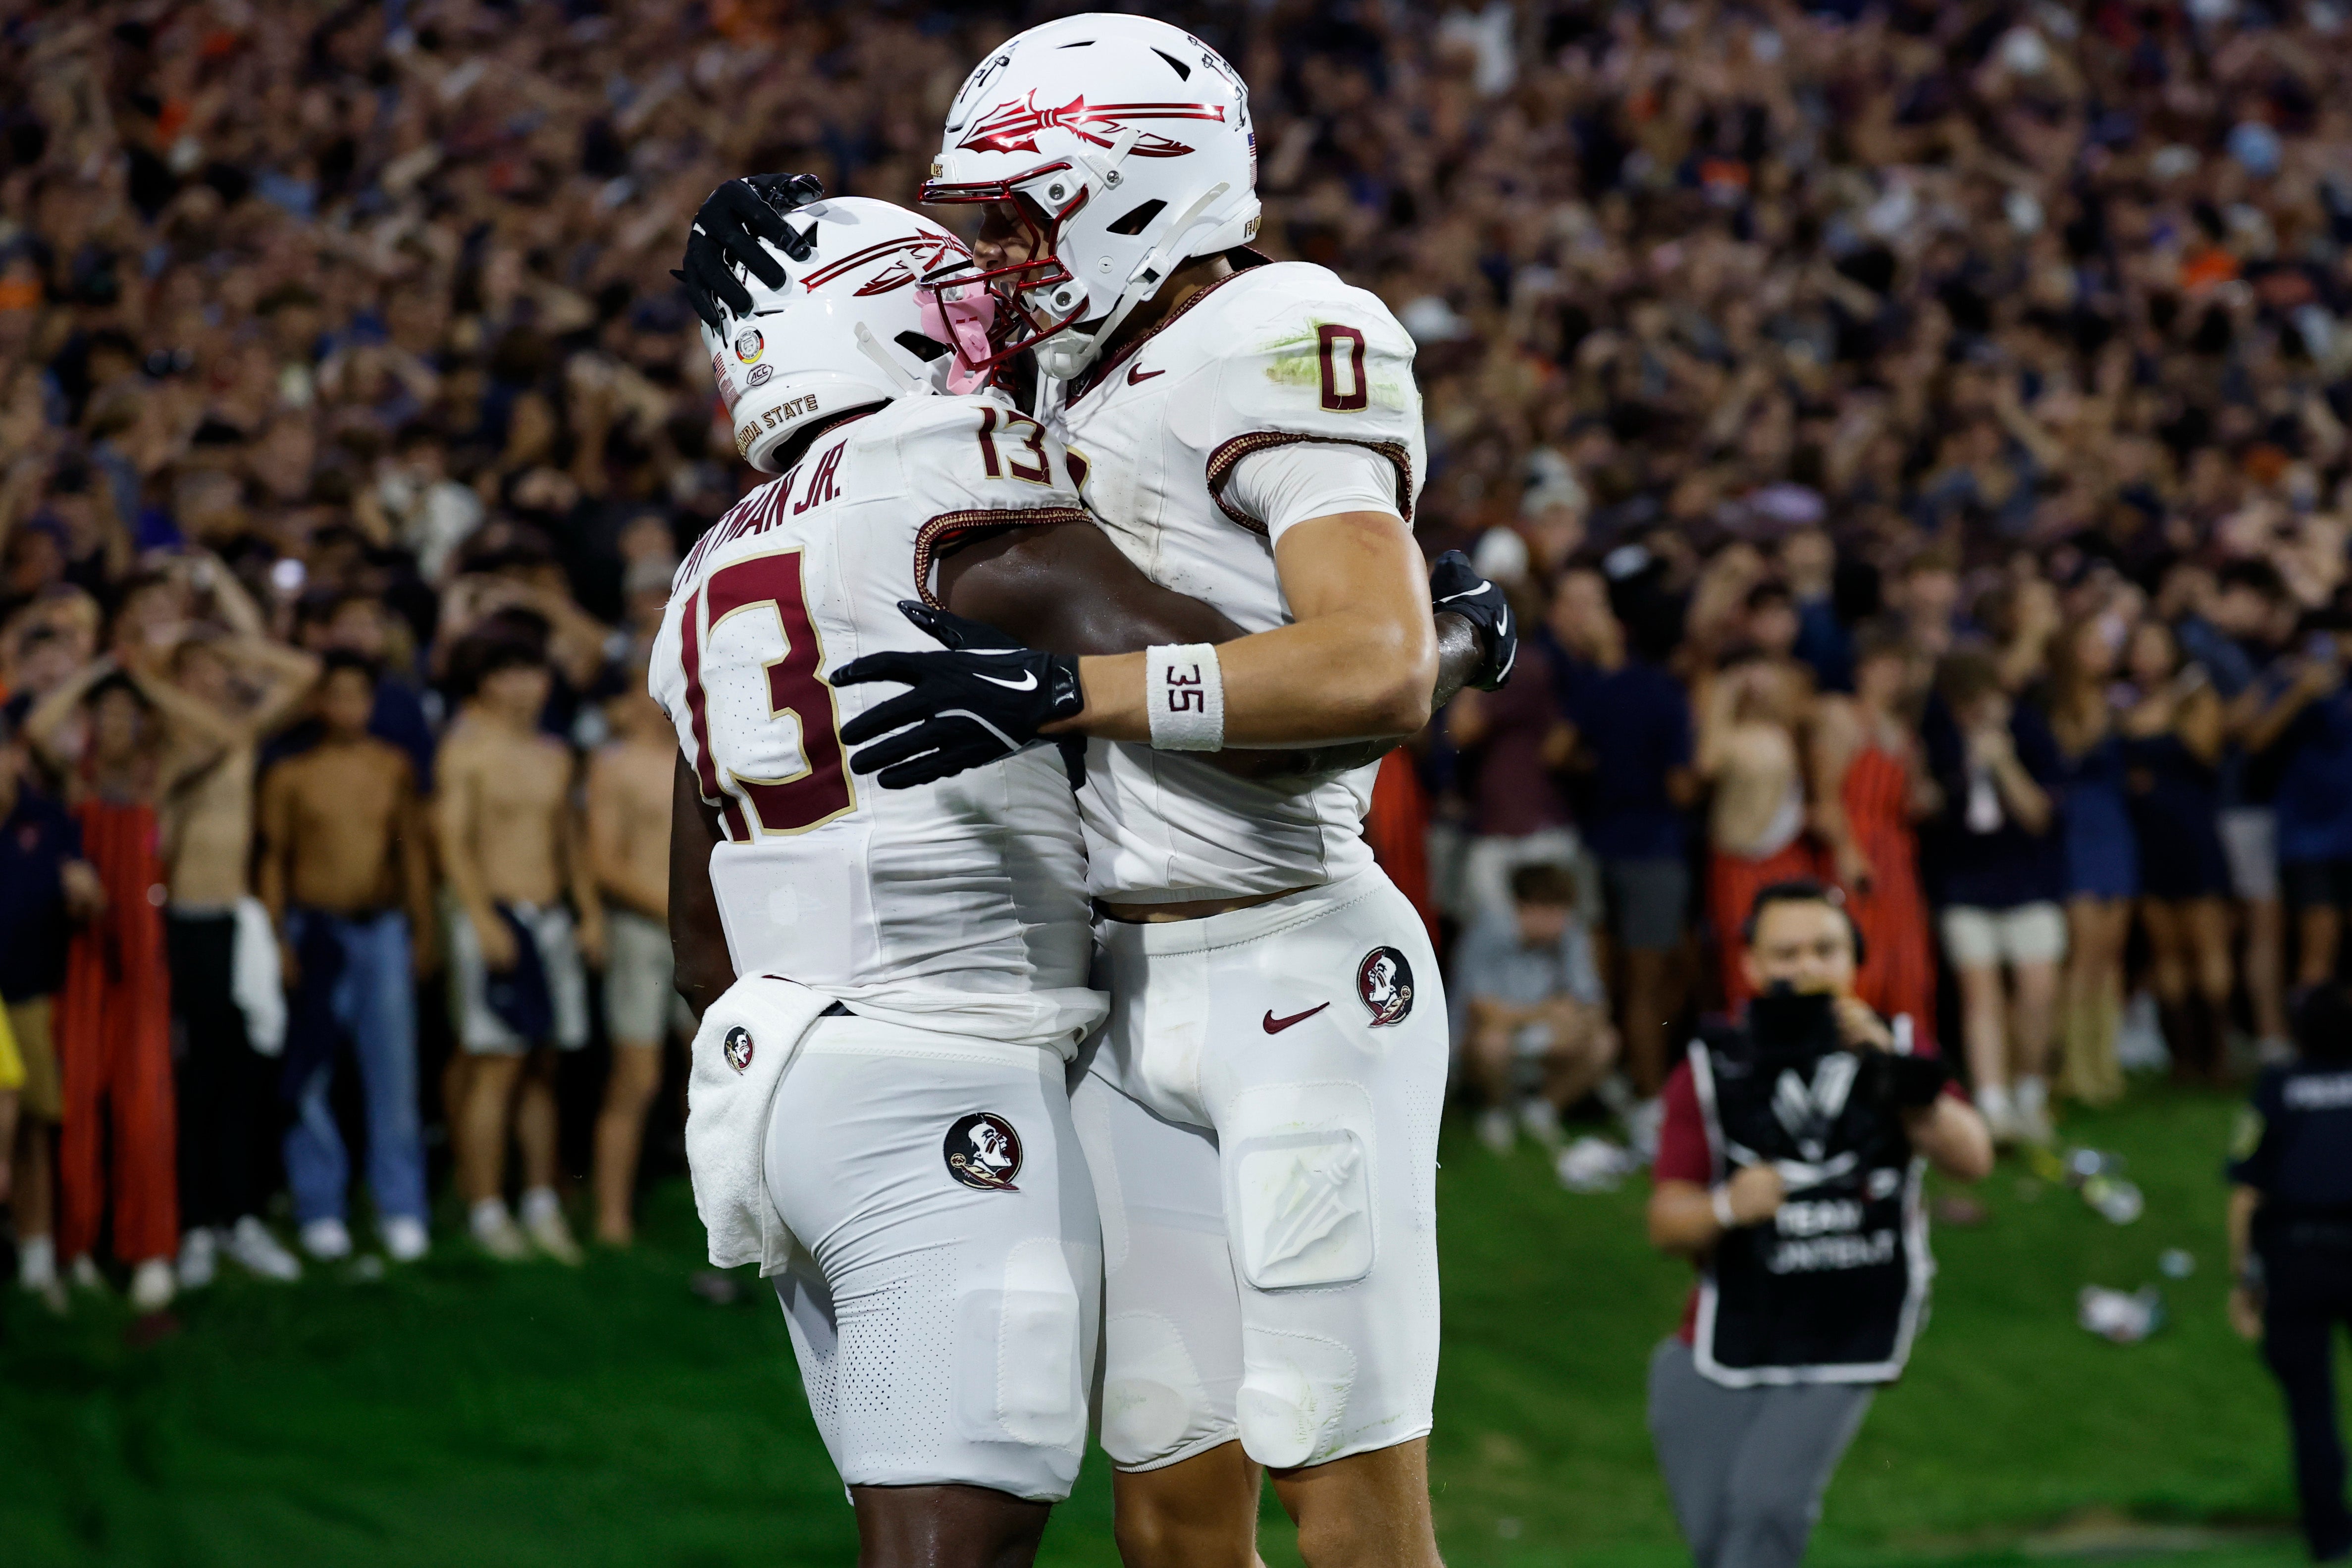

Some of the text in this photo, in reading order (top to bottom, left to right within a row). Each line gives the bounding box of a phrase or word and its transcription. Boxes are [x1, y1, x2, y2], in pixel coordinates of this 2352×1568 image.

[761, 394, 818, 428] STATE
[973, 405, 1054, 489] 13
[793, 438, 848, 516] JR.
[680, 545, 857, 845] 13
[1166, 664, 1204, 713] 35
